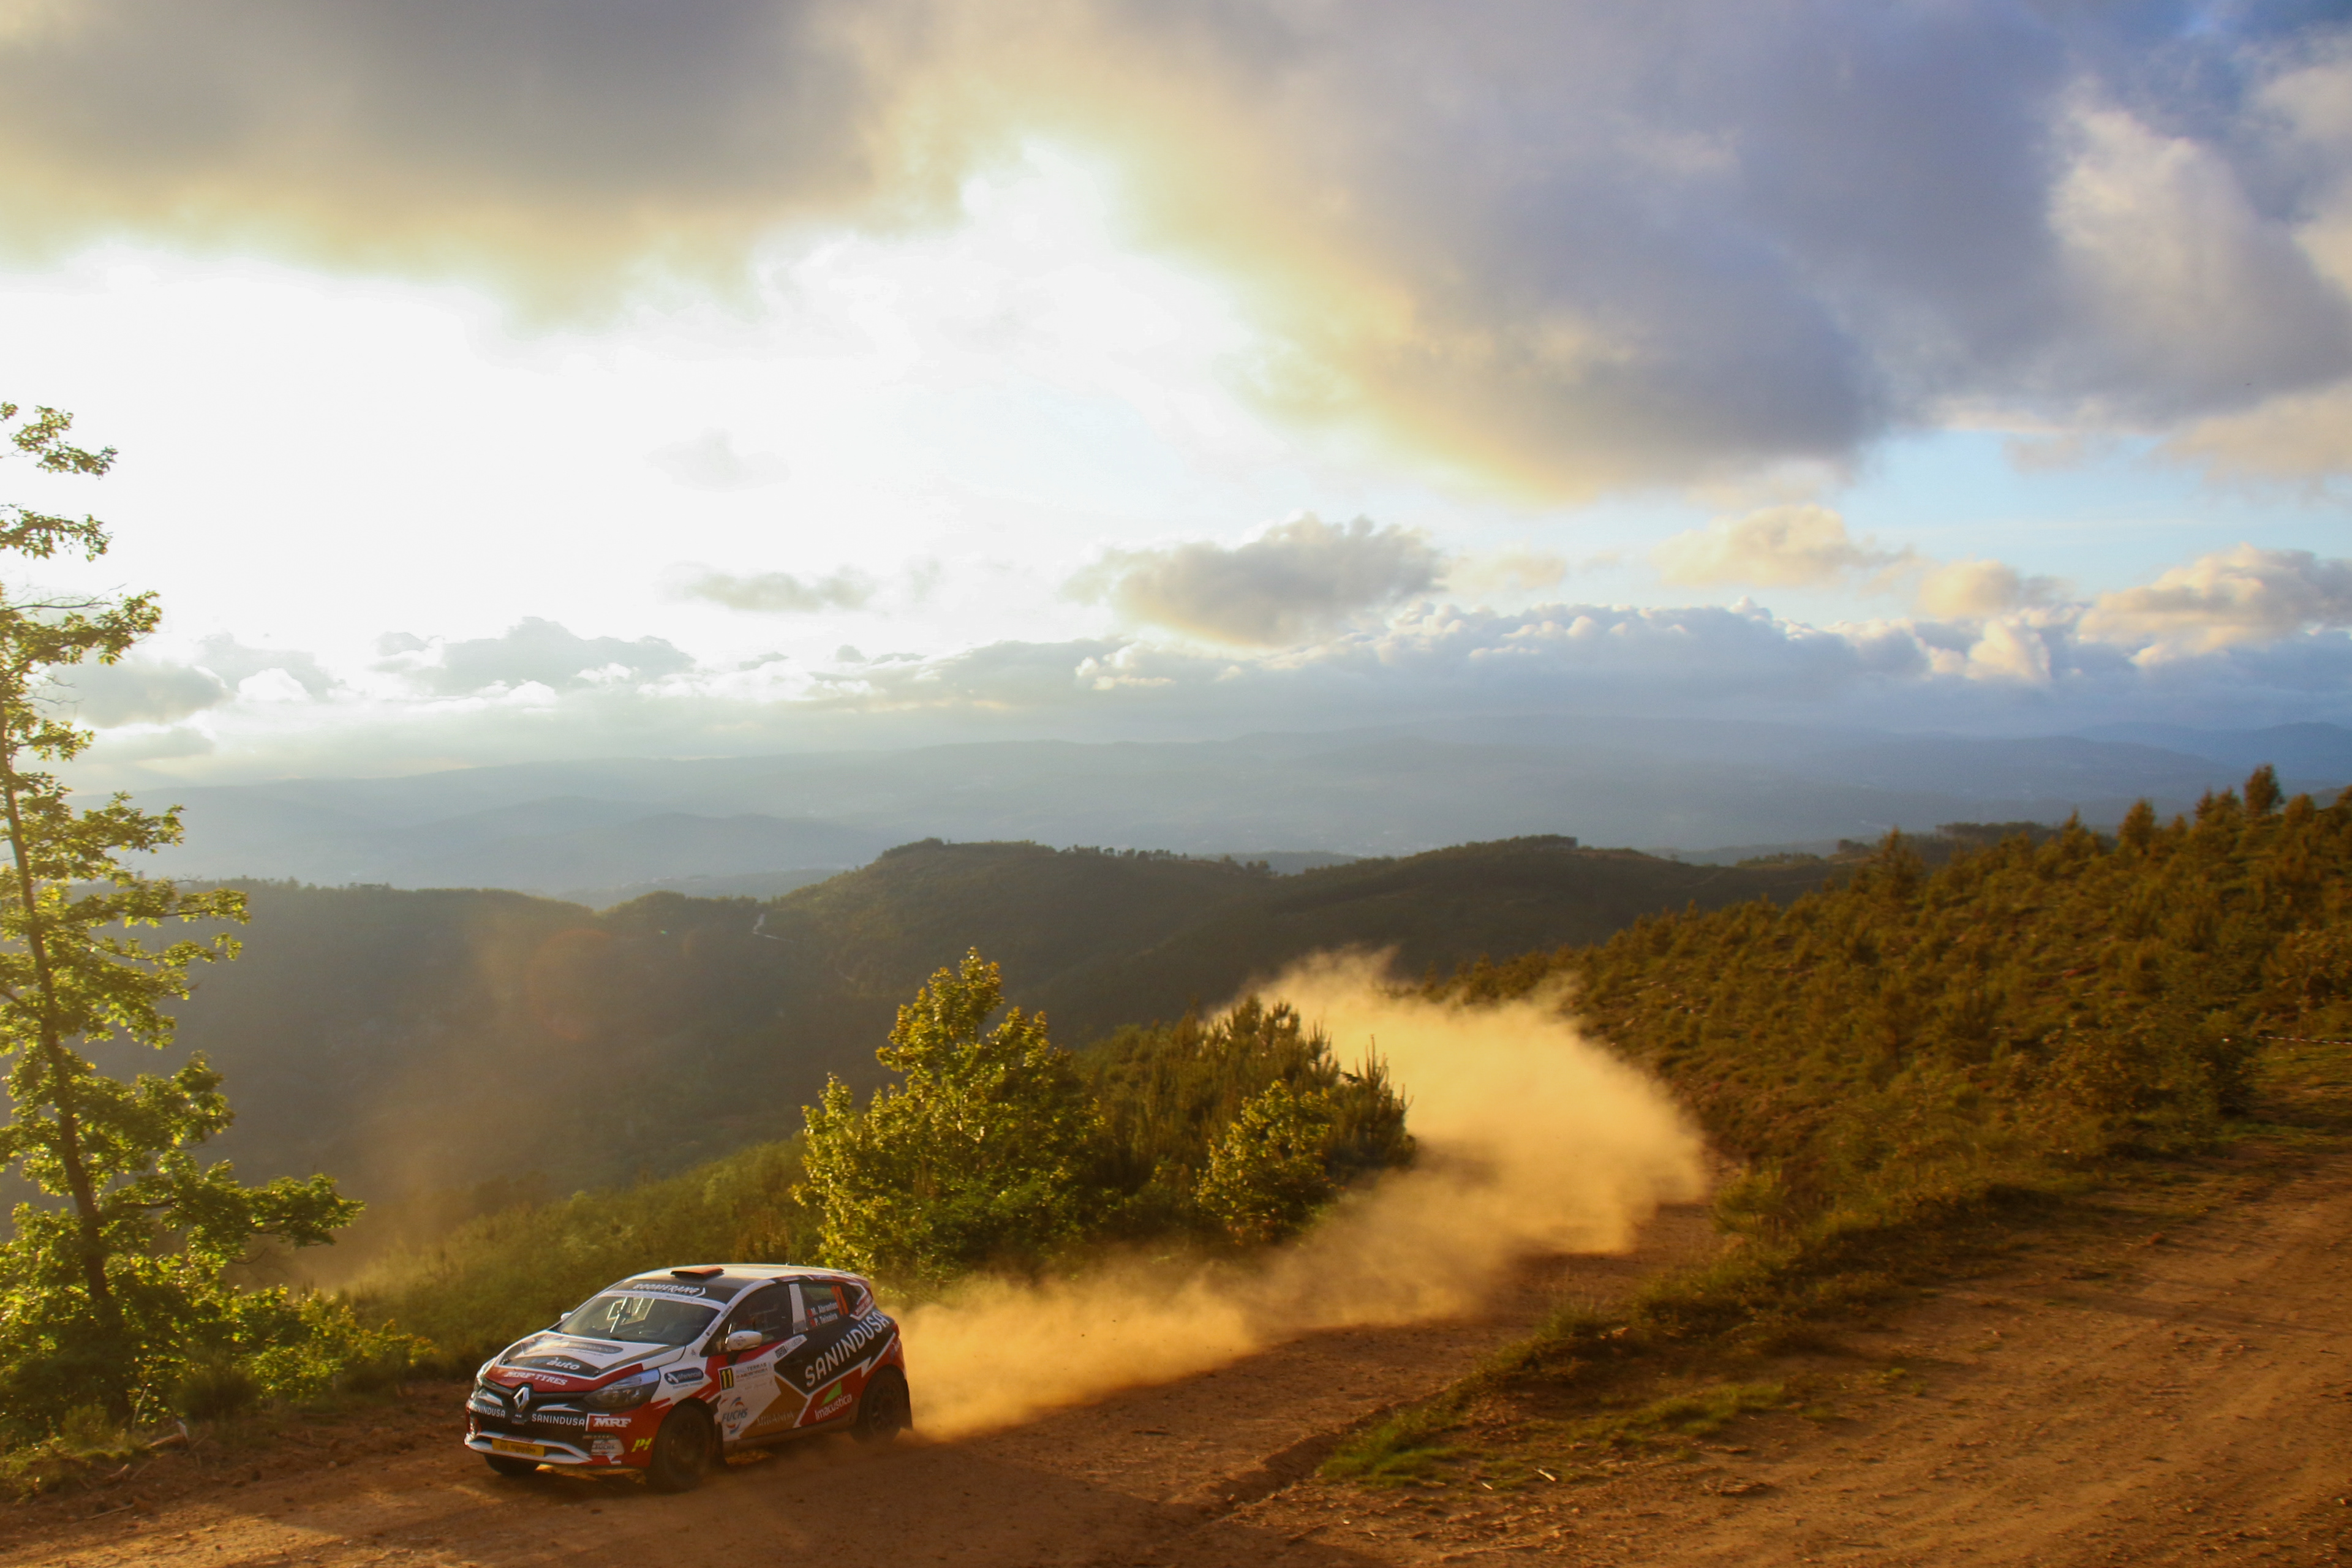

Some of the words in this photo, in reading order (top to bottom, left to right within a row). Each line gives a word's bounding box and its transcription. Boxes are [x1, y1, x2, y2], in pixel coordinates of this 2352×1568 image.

[632, 1283, 699, 1294] BOOMERANG
[831, 1286, 850, 1315] 11
[805, 1310, 890, 1387] SANINDUSA
[535, 1374, 568, 1386] TYRES
[722, 1369, 733, 1389] 11
[532, 1413, 586, 1427] SANINDUSA
[722, 1408, 748, 1422] FUCHS
[593, 1417, 632, 1428] MRF
